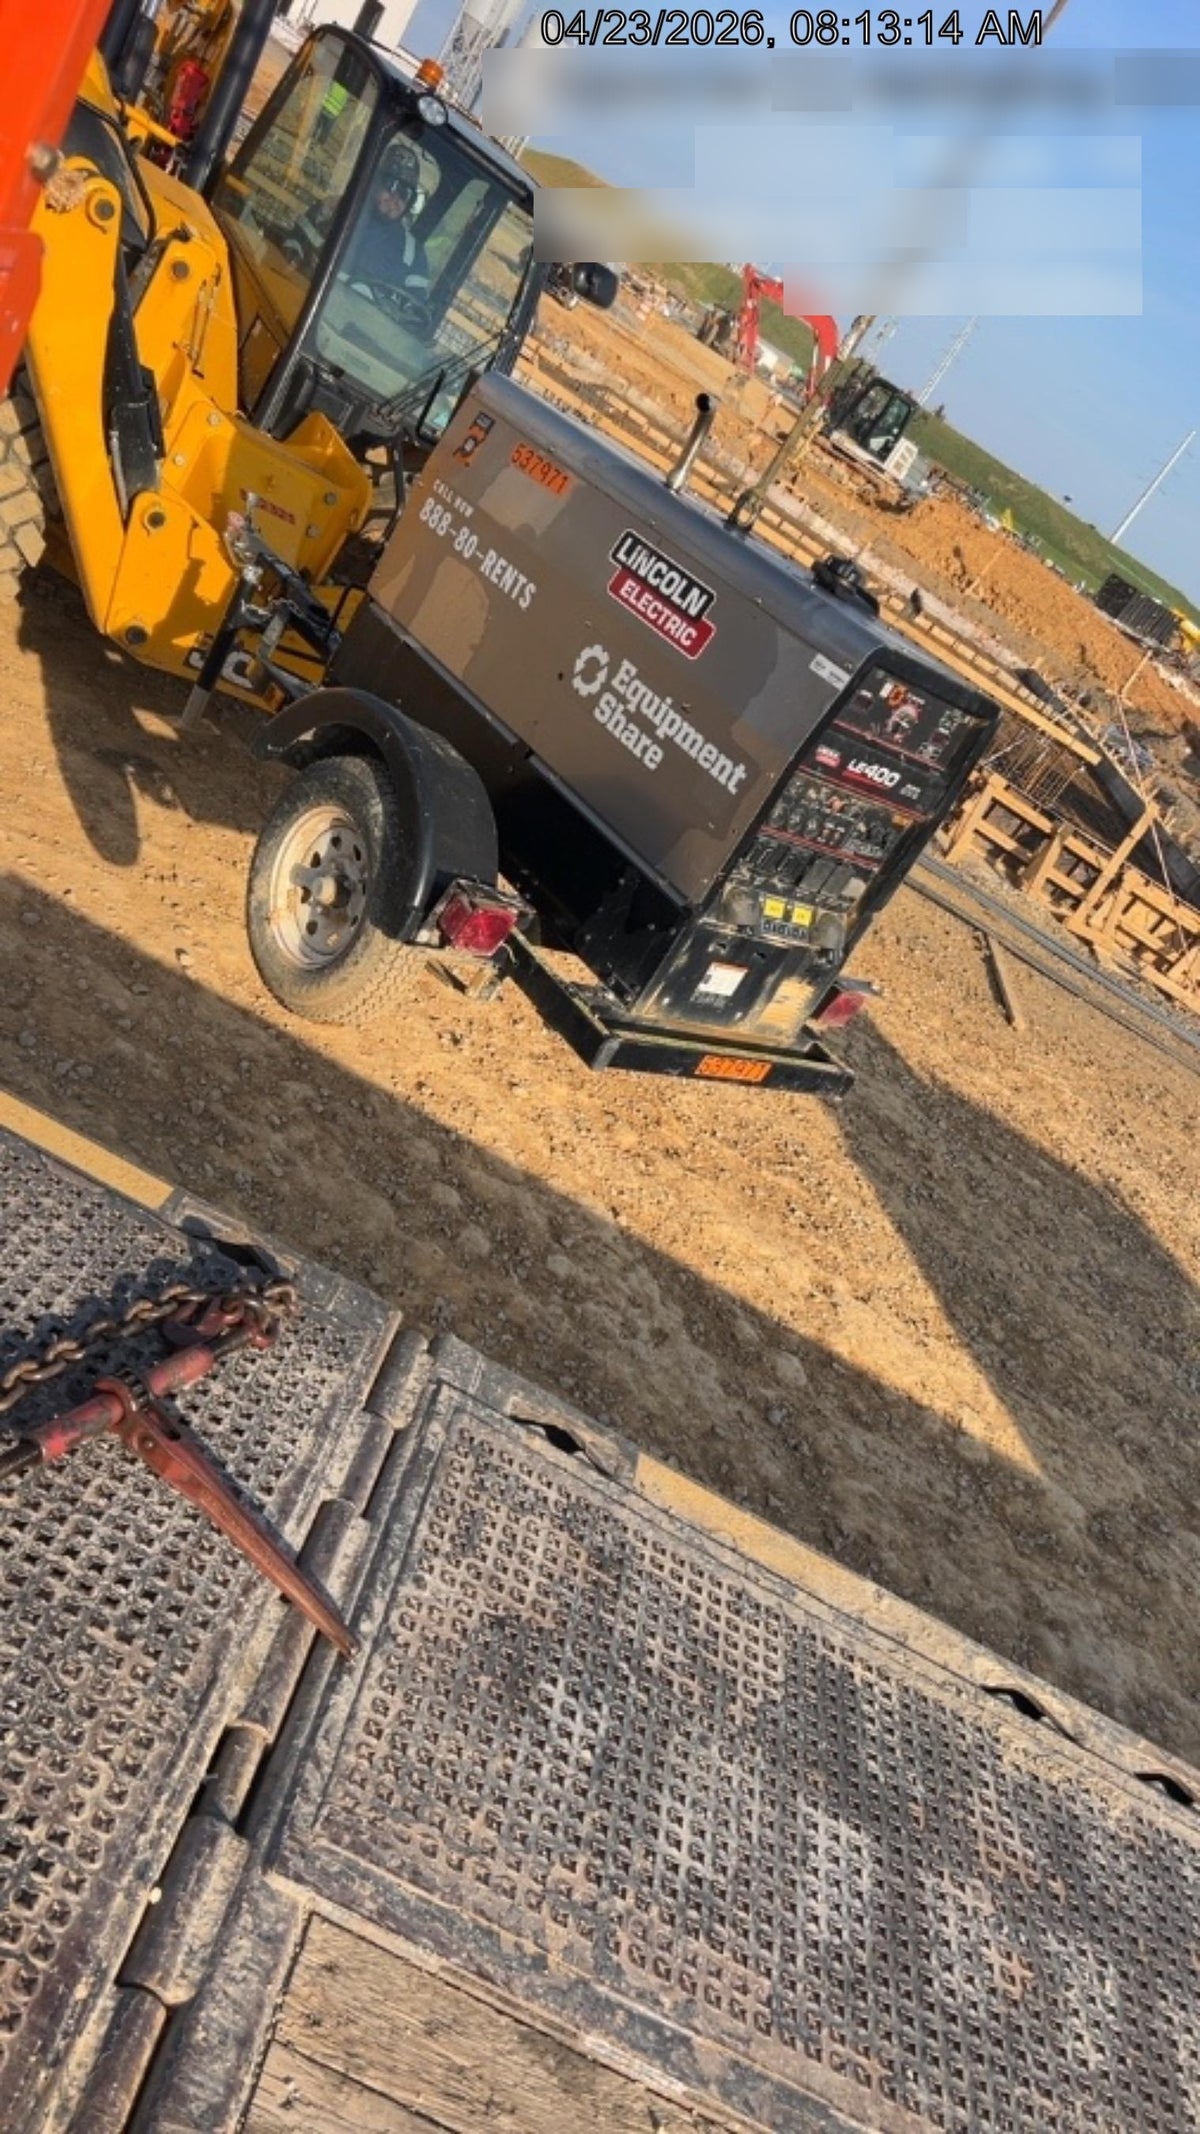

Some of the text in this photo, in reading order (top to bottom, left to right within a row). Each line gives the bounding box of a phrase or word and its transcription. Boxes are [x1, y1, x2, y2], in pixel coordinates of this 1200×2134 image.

[511, 442, 570, 495] 537971
[419, 497, 537, 609] 888-80-RENTS
[616, 536, 708, 618] LINCOLN
[619, 579, 698, 647] ELECTRIC
[594, 692, 665, 770] Share
[611, 658, 748, 796] Equipment
